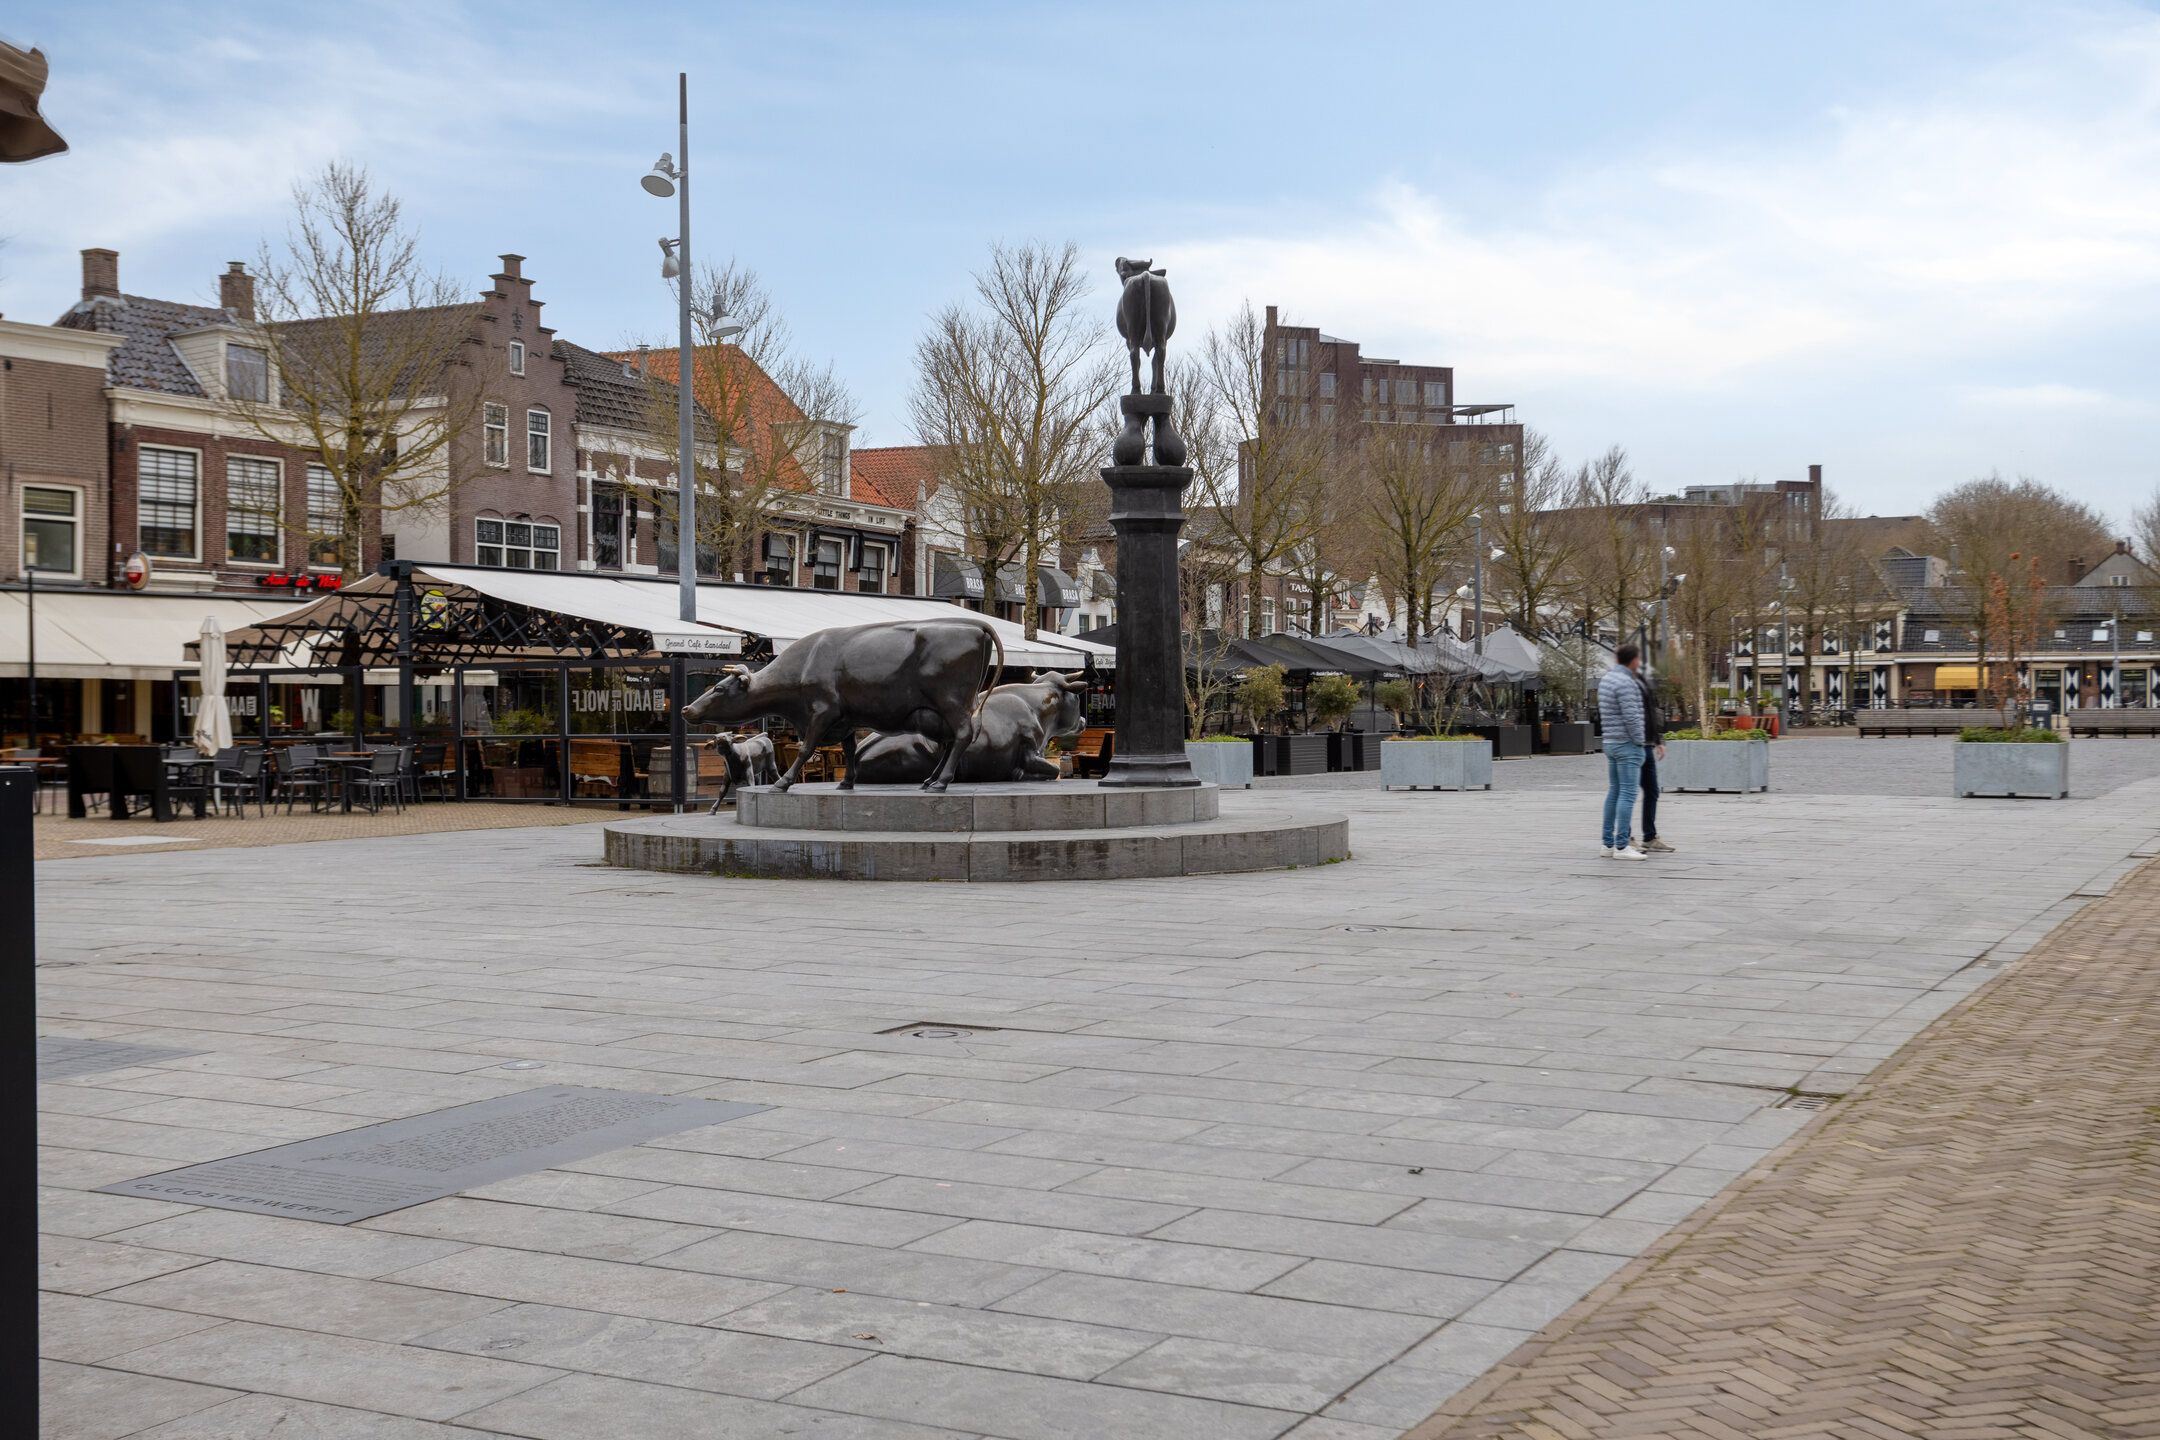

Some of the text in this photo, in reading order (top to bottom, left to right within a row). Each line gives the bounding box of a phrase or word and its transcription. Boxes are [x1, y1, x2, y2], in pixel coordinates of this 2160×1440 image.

[818, 508, 886, 525] LITTLE THINGS IN LIFE
[965, 577, 984, 591] BRASA
[1062, 589, 1079, 601] BRASA
[664, 638, 685, 649] Grand
[687, 639, 702, 650] Café
[134, 1183, 353, 1216] CLOOSTERWERFF
